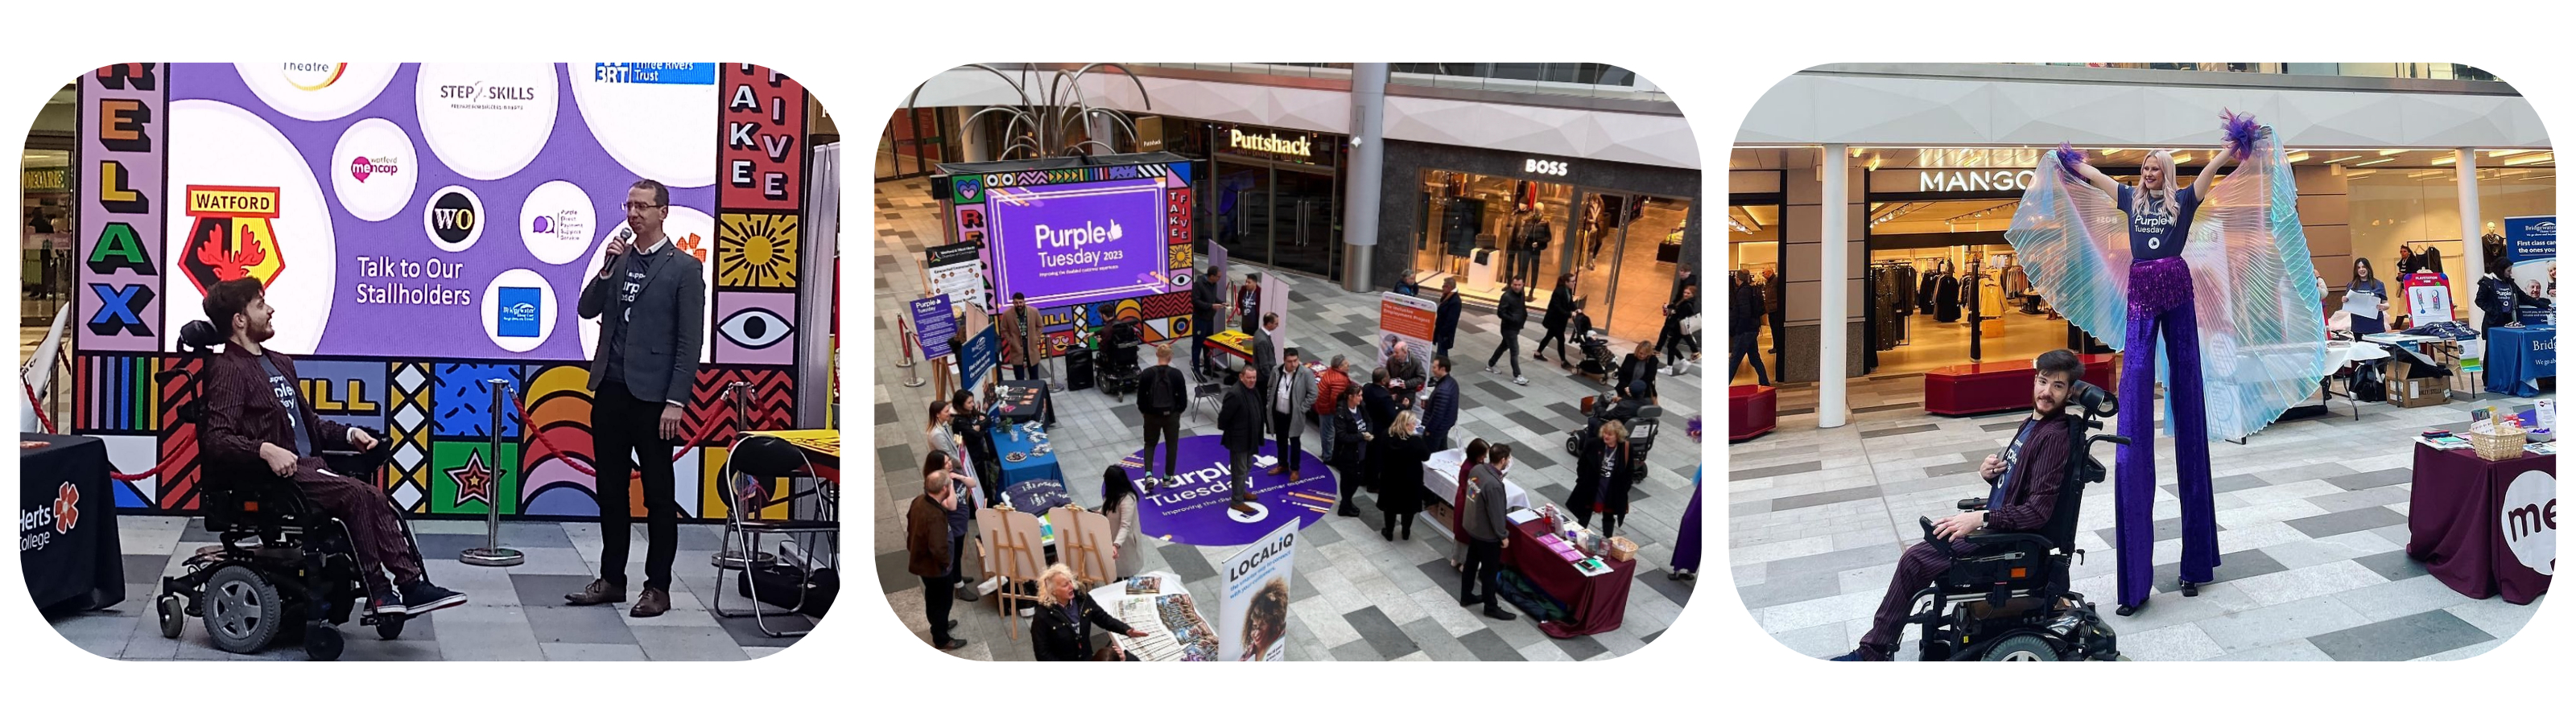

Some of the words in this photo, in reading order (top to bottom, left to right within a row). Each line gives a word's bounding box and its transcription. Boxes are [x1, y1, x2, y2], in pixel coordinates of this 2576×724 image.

[634, 69, 659, 81] Trust
[440, 85, 474, 99] STEP
[489, 86, 535, 101] SKILLS
[1231, 129, 1311, 156] Puttshack
[352, 163, 398, 176] mencap
[1525, 158, 1568, 176] BOSS
[1920, 170, 2035, 192] MANGO
[196, 194, 270, 210] WATFORD
[434, 208, 473, 230] WO
[1170, 191, 1180, 237] TAKE
[1180, 195, 1189, 240] FIVE
[2134, 215, 2168, 227] Purple
[1034, 220, 1106, 249] Purple
[2134, 225, 2165, 235] Tuesday
[357, 256, 395, 278] Talk
[400, 259, 421, 278] to
[427, 258, 464, 279] Our
[1038, 248, 1101, 268] Tuesday
[1103, 250, 1123, 261] 2023
[357, 282, 472, 306] Stallholders
[915, 299, 936, 309] Purple
[20, 532, 51, 551] ollege
